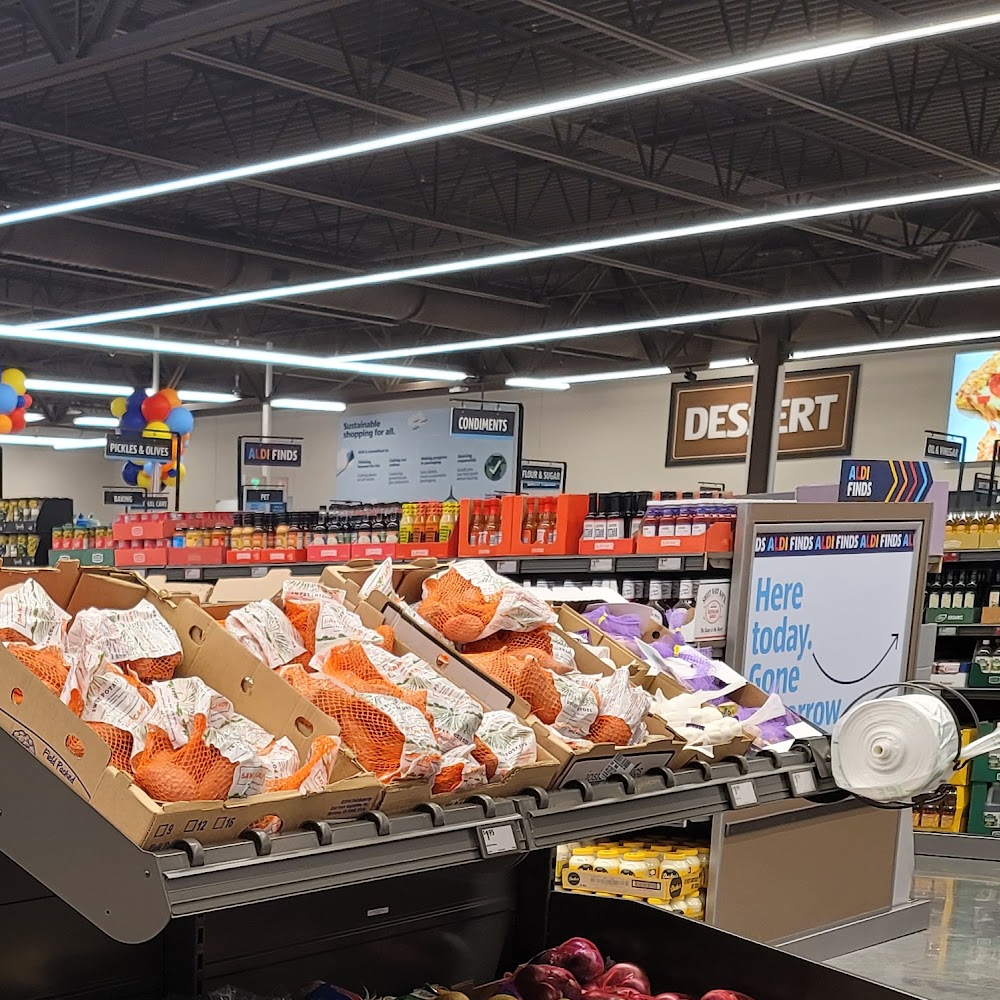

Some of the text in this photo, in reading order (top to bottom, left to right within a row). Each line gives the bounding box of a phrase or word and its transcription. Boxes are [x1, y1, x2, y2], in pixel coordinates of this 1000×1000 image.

[458, 416, 508, 432] CONDIMENTS
[684, 393, 839, 441] DESERT
[343, 420, 381, 430] Sustainable
[343, 427, 396, 439] shopping for all.
[110, 443, 169, 457] PICKLES & OLIVES
[248, 448, 298, 461] ALDI FINDS
[522, 470, 538, 479] FLOUR
[544, 471, 560, 480] SUGAR
[848, 465, 871, 481] ALDI
[846, 481, 873, 497] FINDS
[113, 495, 133, 503] BAKING
[260, 493, 270, 501] PET
[767, 536, 789, 551] ALDI
[789, 535, 814, 551] FINDS
[814, 534, 835, 550] ALDI
[835, 534, 859, 549] FINDS
[859, 533, 880, 548] ALDI
[880, 533, 902, 548] FINDS
[755, 576, 804, 613] Here
[752, 616, 813, 662] today.
[750, 663, 800, 694] Gone
[42, 747, 77, 785] Field Packed
[166, 824, 175, 836] 9
[199, 820, 208, 832] 12
[225, 817, 236, 829] 16
